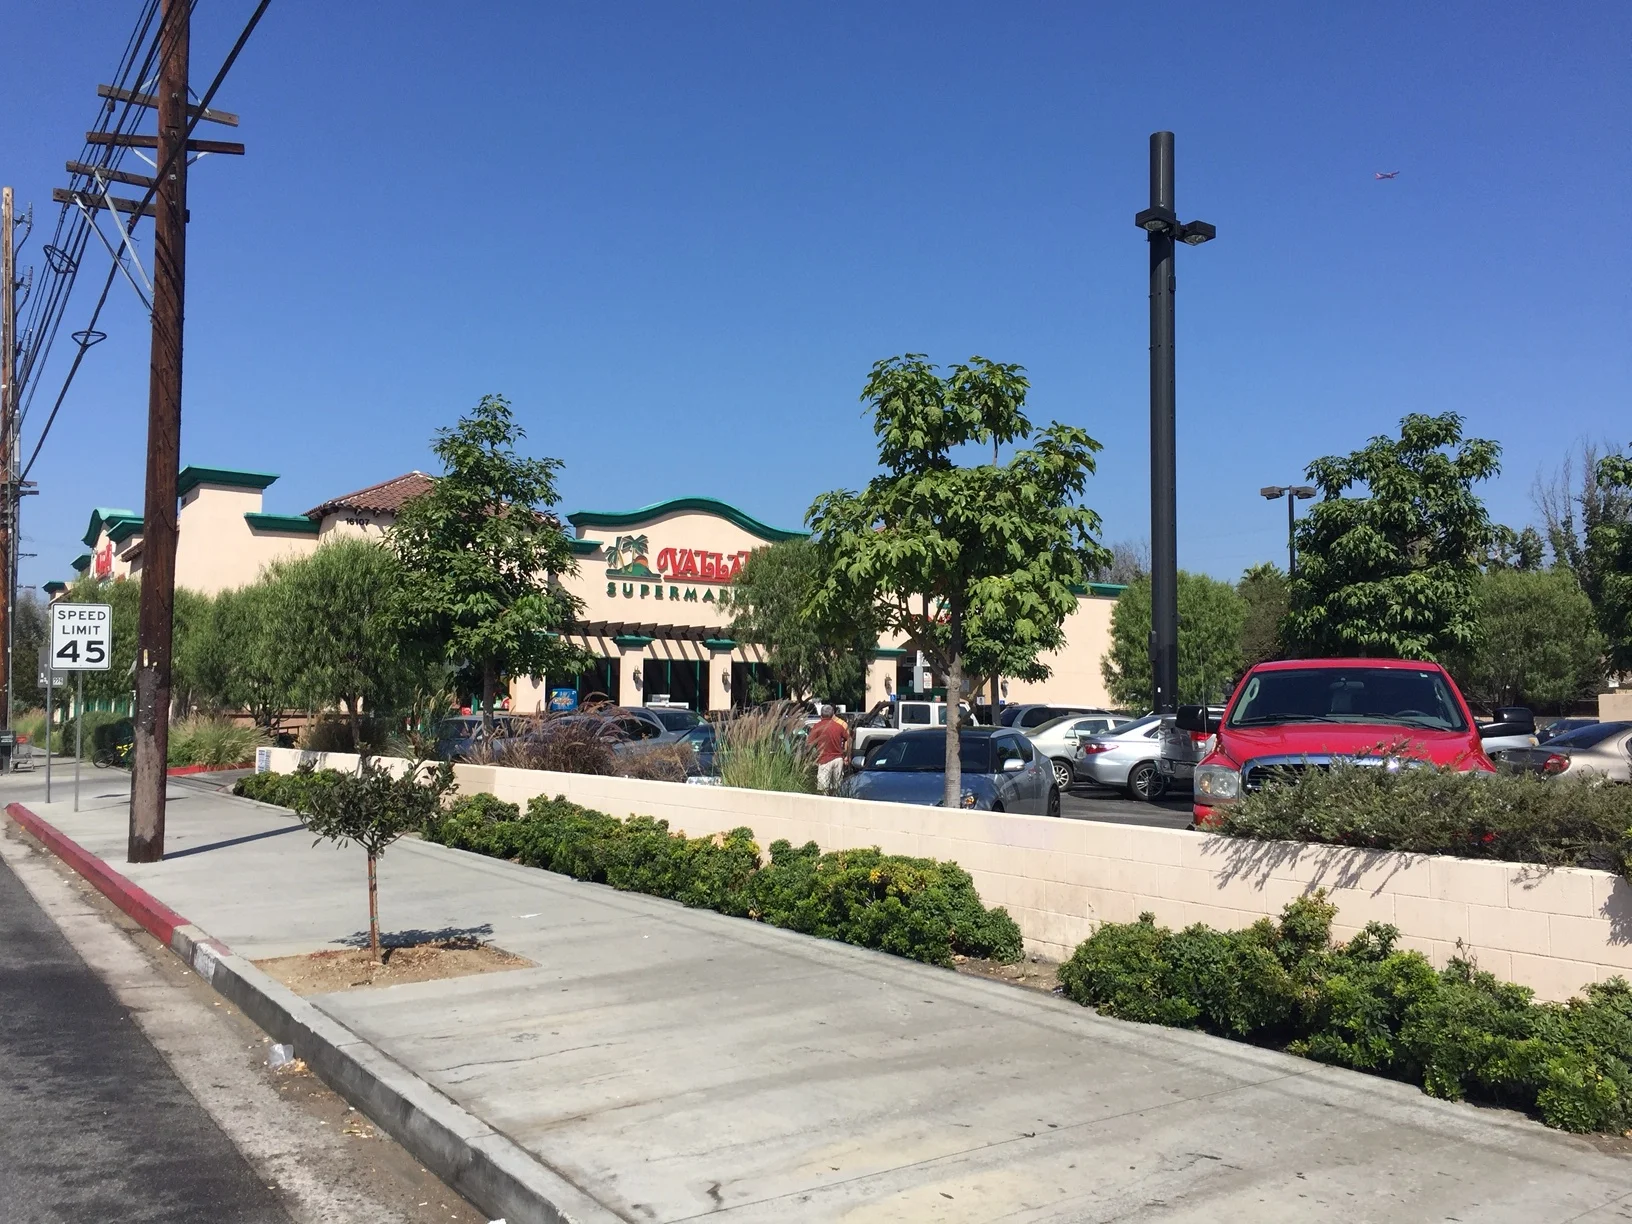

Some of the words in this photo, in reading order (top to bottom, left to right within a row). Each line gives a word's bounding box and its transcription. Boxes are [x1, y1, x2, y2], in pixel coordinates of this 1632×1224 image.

[345, 517, 370, 526] 16107
[657, 547, 760, 577] VALLA
[607, 581, 744, 603] SUPERMAR
[58, 610, 106, 621] SPEED
[62, 625, 101, 635] LIMIT
[56, 639, 106, 663] 45
